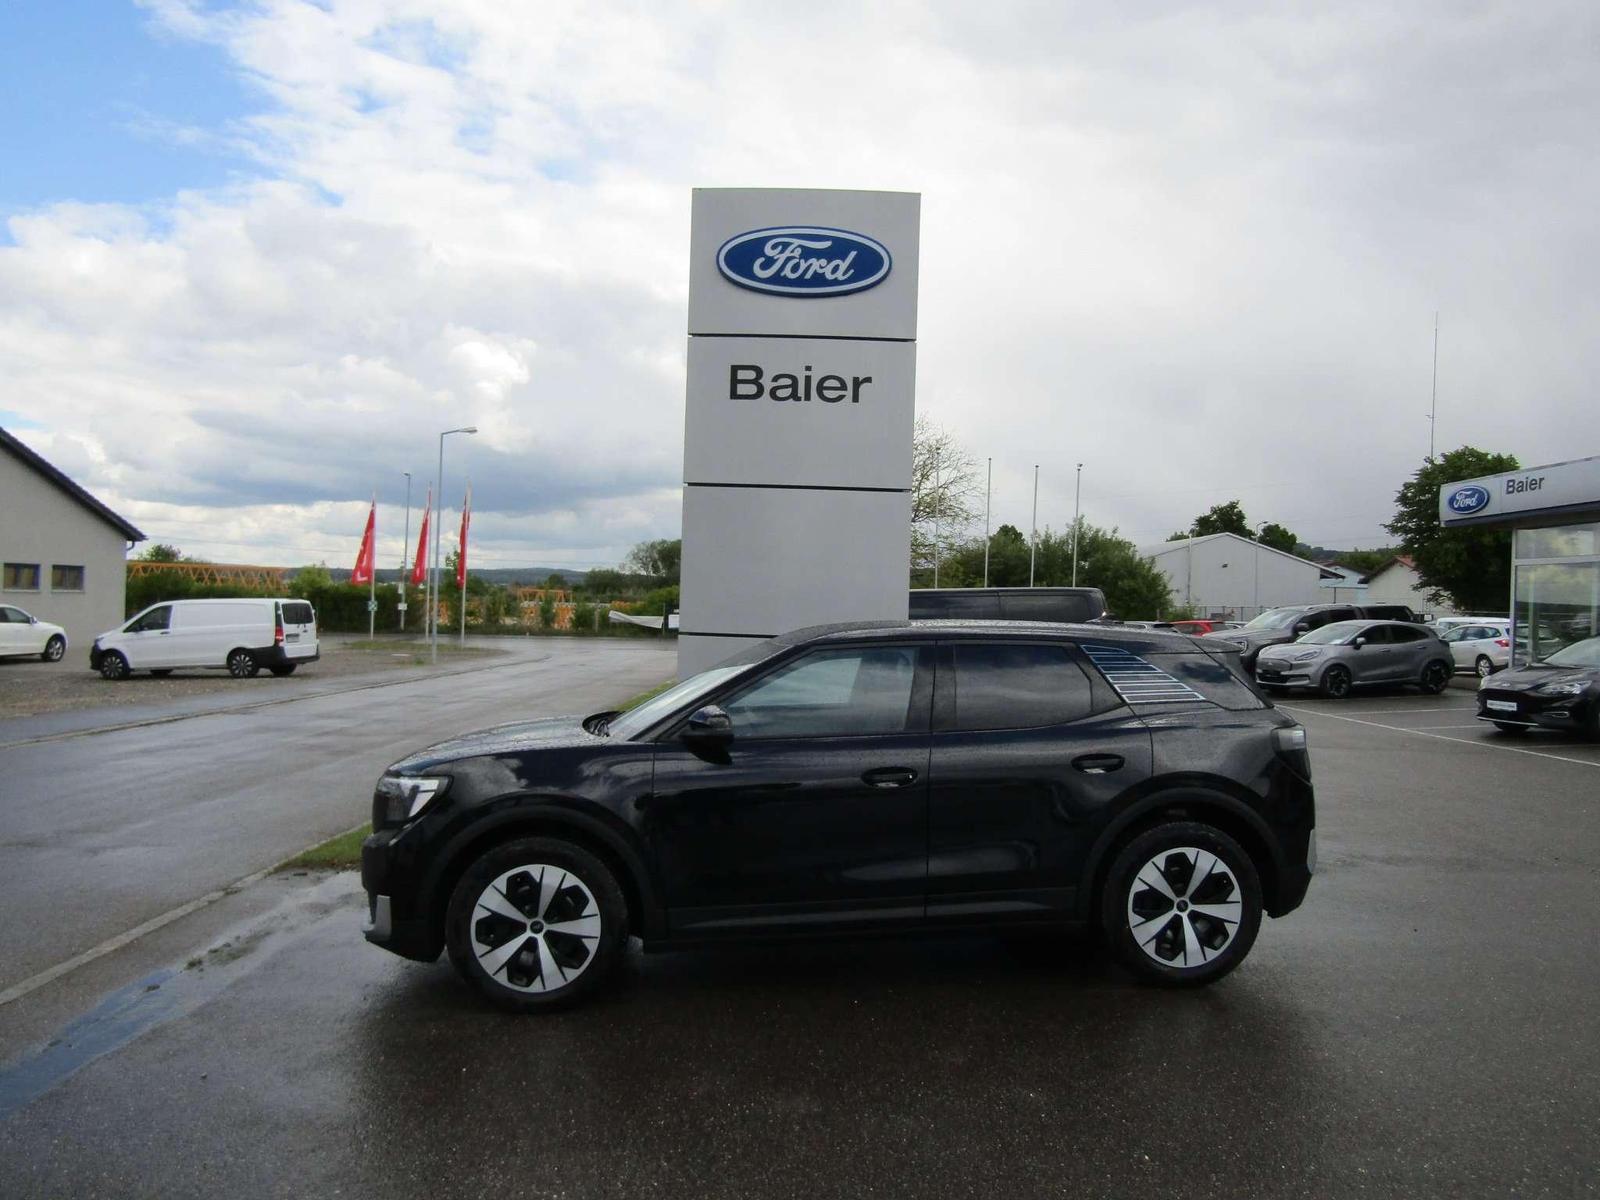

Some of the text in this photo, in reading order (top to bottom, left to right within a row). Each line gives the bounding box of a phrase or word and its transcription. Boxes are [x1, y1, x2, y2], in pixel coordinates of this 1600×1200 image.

[753, 237, 857, 281] Ford
[729, 364, 872, 403] Baier
[1453, 490, 1478, 508] Ford
[1505, 476, 1545, 495] Baier
